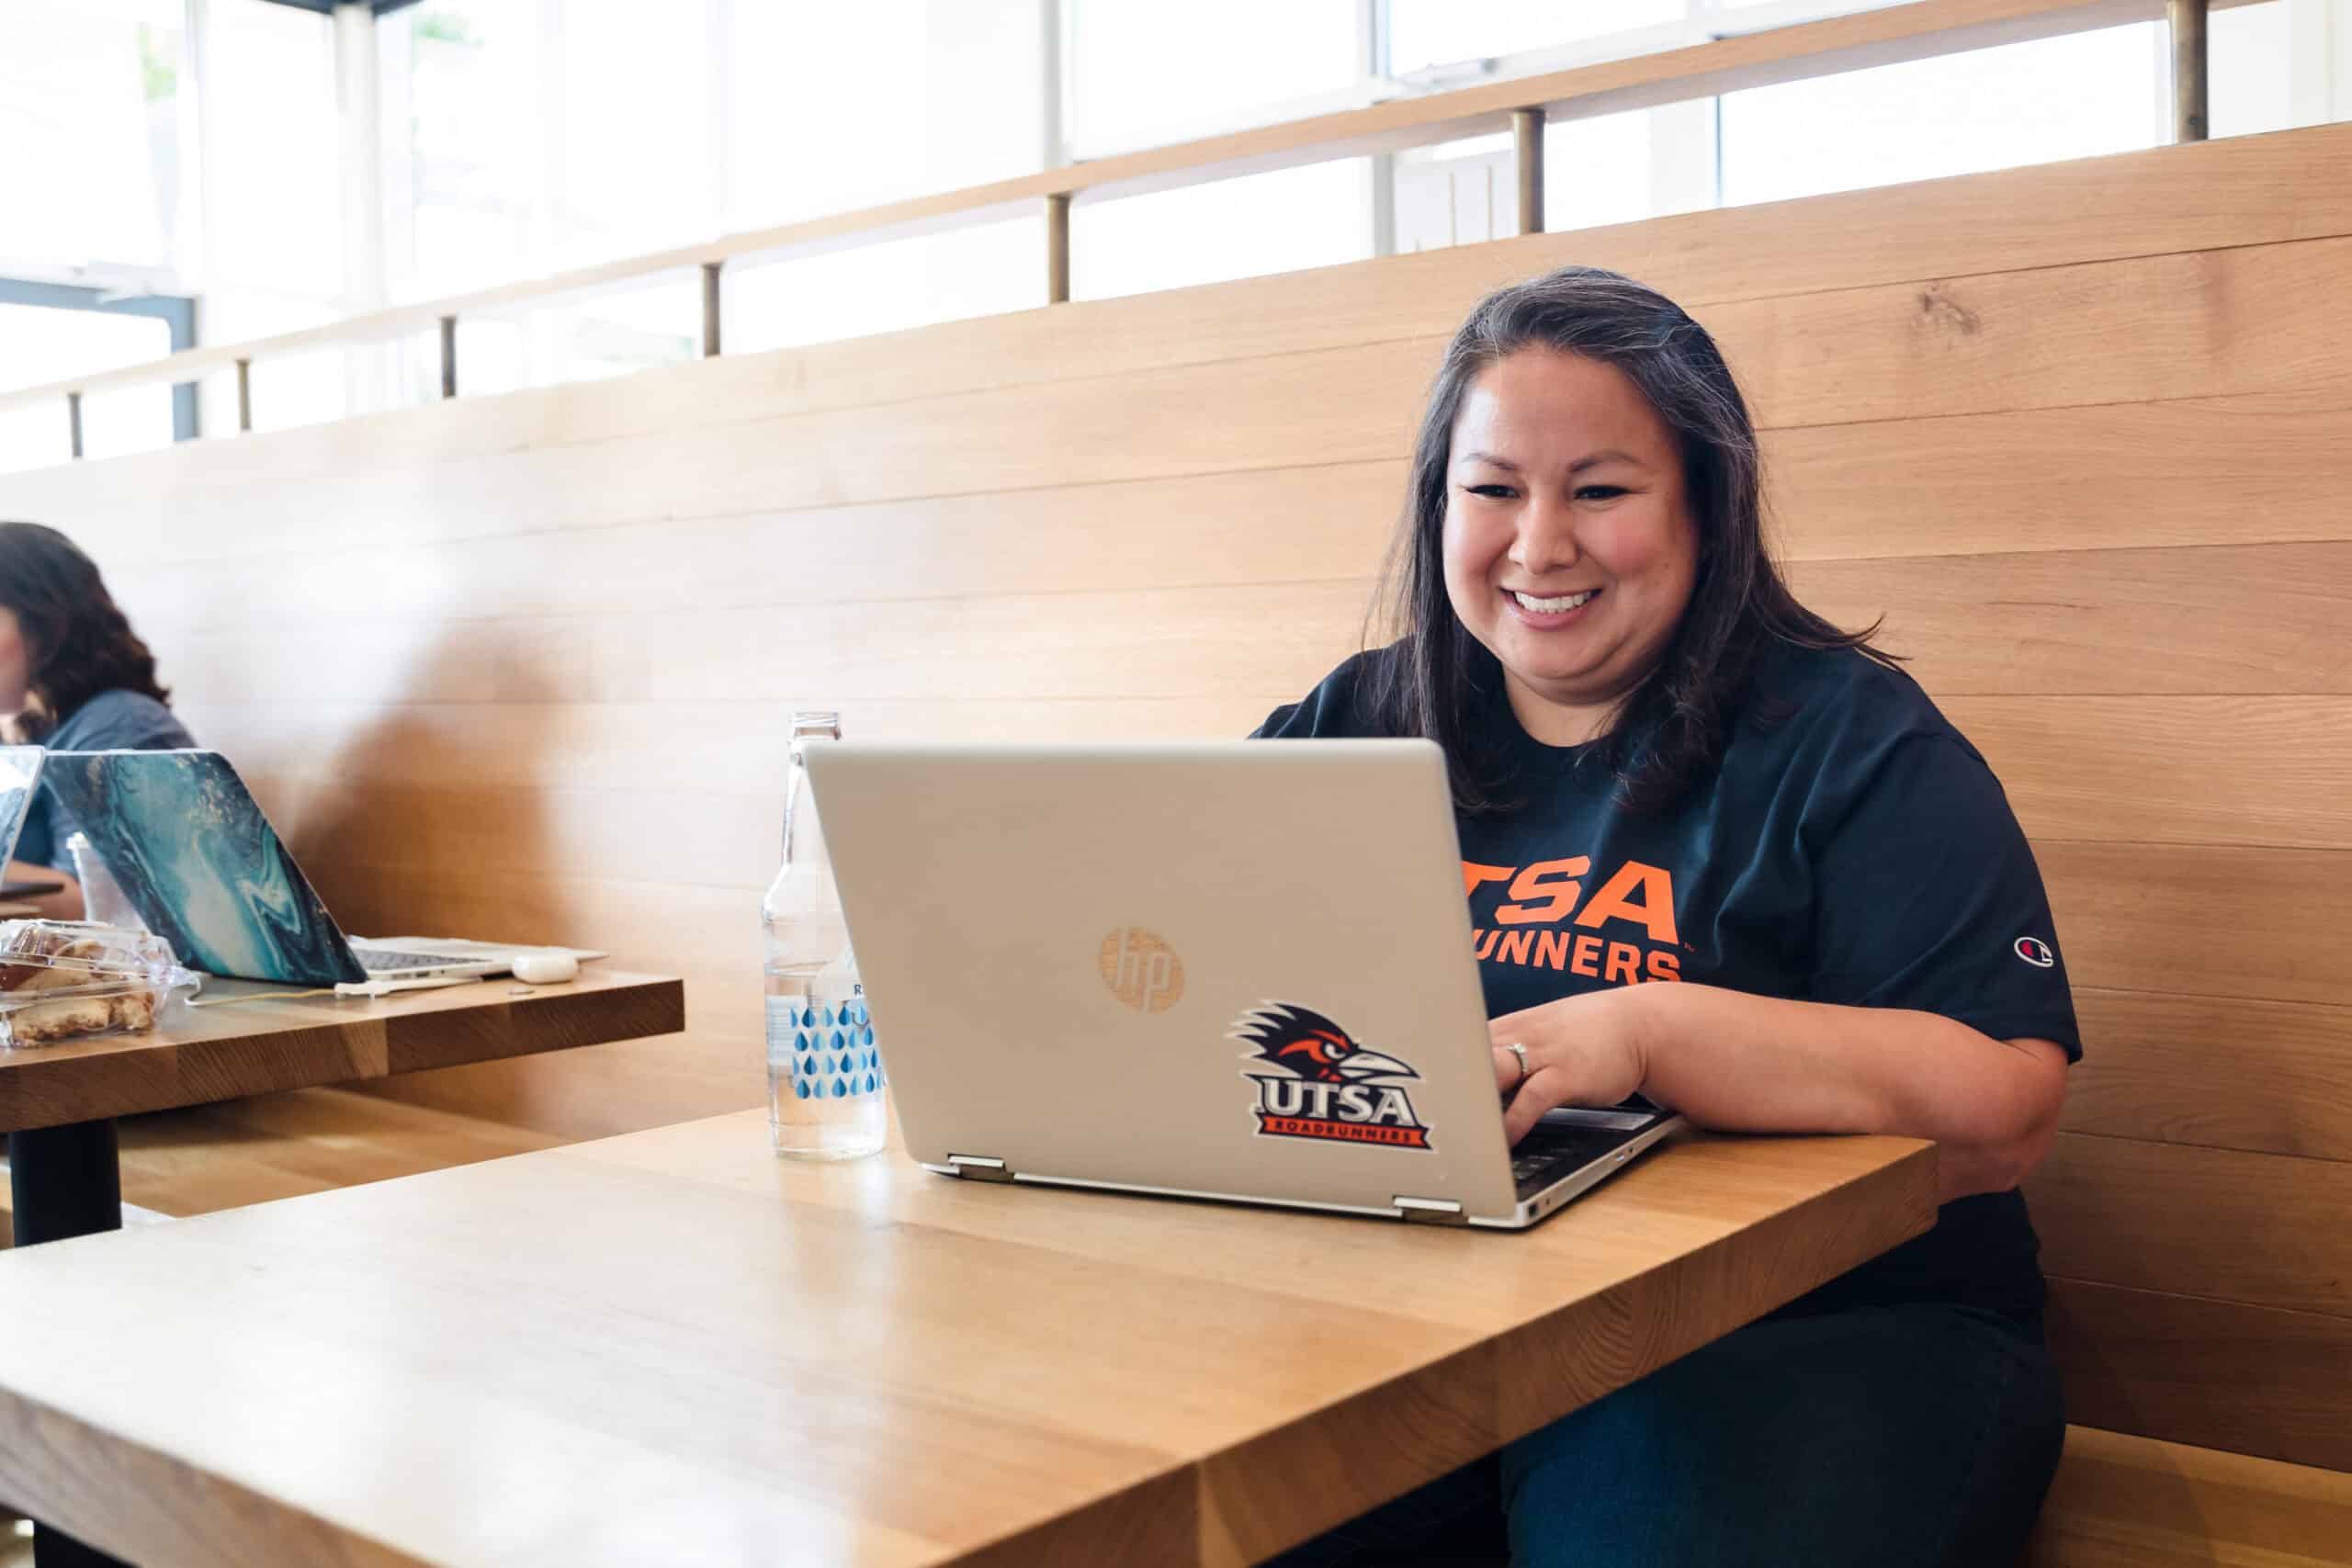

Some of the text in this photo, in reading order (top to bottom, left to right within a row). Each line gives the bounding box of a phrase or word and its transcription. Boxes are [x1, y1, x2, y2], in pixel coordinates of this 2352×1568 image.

[1112, 928, 1171, 1012] hp
[1263, 1078, 1416, 1126] UTSA
[1275, 1119, 1411, 1143] ROADRUNNERS
